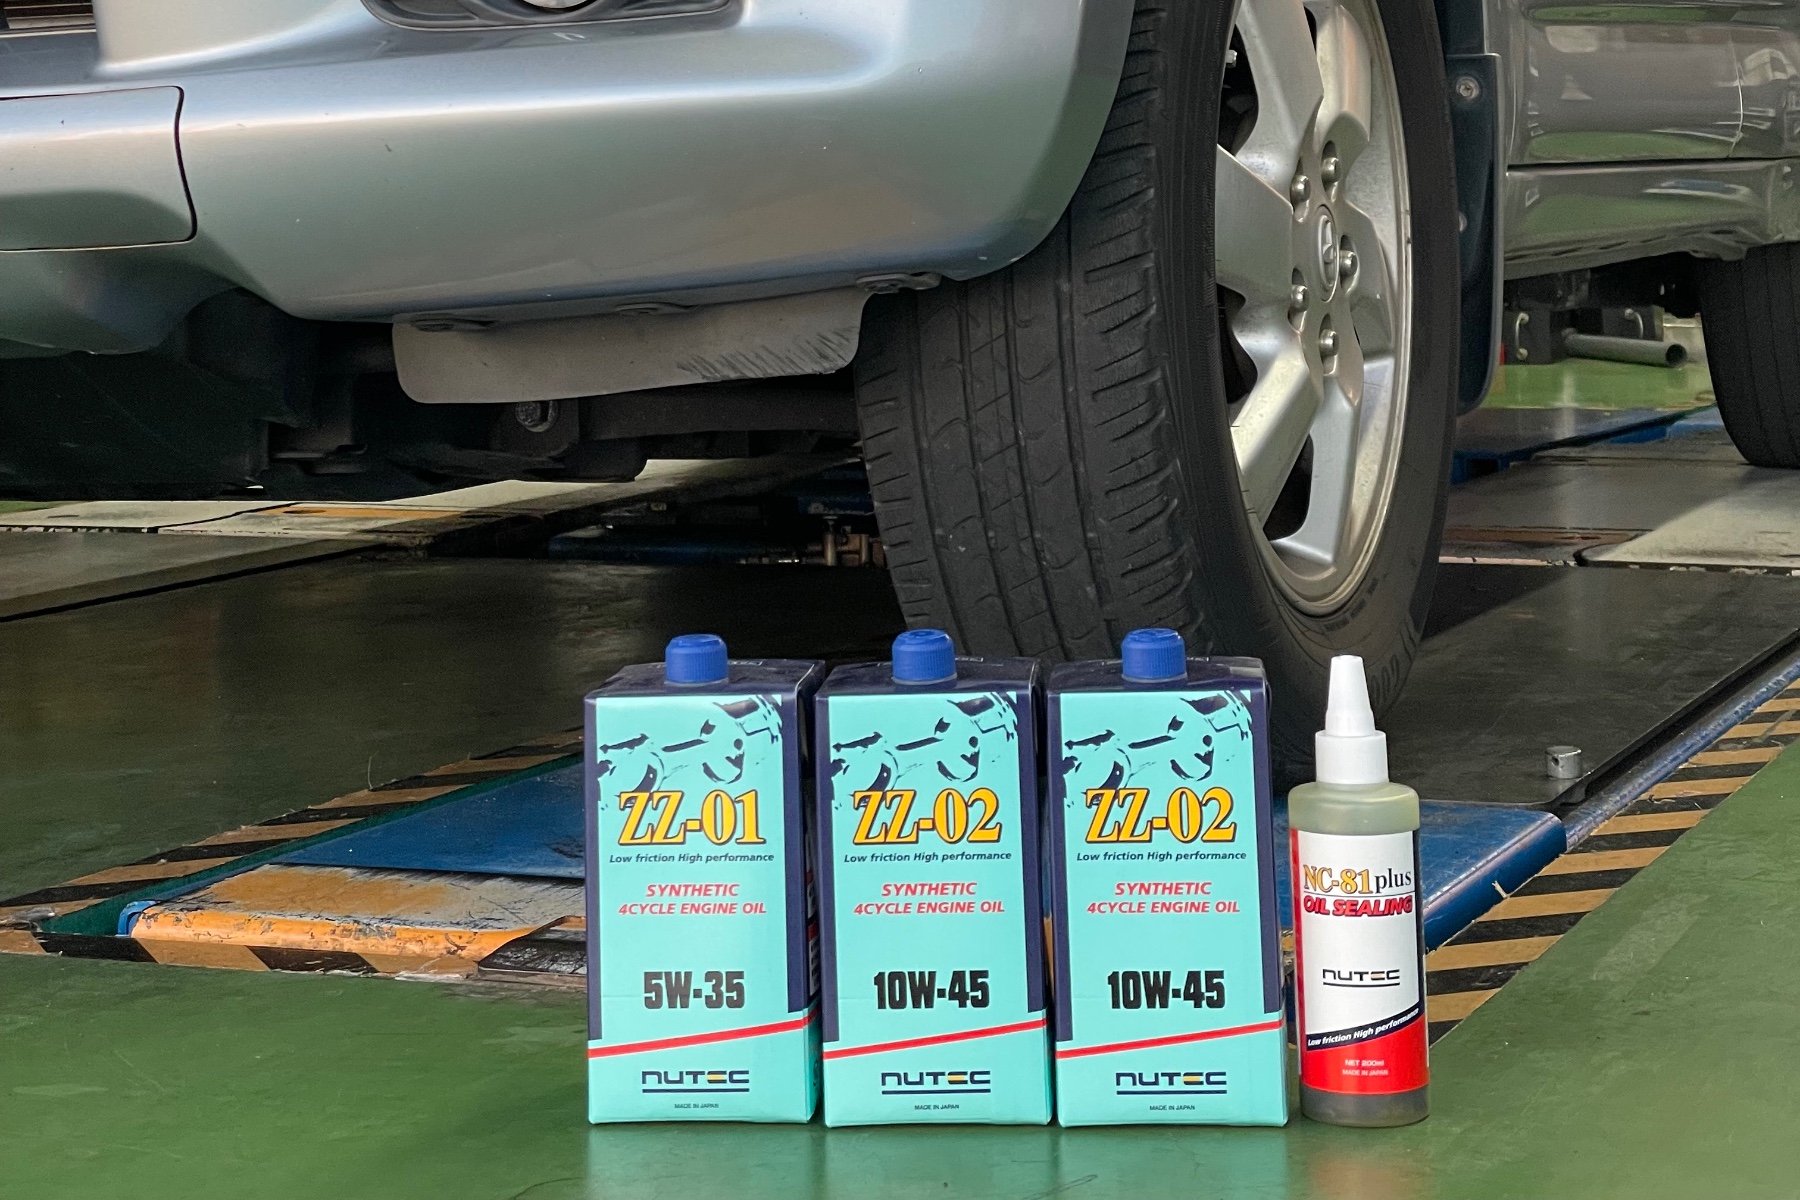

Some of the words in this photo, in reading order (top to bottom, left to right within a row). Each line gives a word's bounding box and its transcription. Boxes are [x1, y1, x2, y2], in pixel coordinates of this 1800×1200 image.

[617, 789, 767, 846] ZZ-01
[852, 787, 1003, 845] ZZ-02
[1085, 786, 1238, 844] ZZ-02
[609, 854, 632, 863] Low
[635, 853, 675, 863] friction
[678, 853, 703, 864] High
[705, 853, 775, 863] performance
[844, 854, 866, 863] Low
[870, 853, 910, 862] friction
[914, 852, 939, 863] High
[941, 852, 1012, 862] performance
[1077, 853, 1100, 861] Low
[1103, 852, 1144, 861] friction
[1147, 852, 1173, 862] High
[1175, 851, 1247, 862] performance
[1303, 864, 1373, 894] NC-81
[1375, 868, 1412, 893] plus
[646, 884, 740, 897] SYNTHETIC
[881, 882, 977, 896] SYNTHETIC
[1115, 882, 1212, 895] SYNTHETIC
[618, 903, 675, 915] 4CYCLE
[680, 903, 738, 915] ENGINE
[742, 903, 767, 914] OIL
[854, 902, 911, 915] 4CYCLE
[917, 902, 974, 914] ENGINE
[980, 901, 1005, 913] OIL
[1087, 902, 1146, 914] 4CYCLE
[1151, 902, 1210, 914] ENGINE
[1215, 901, 1240, 913] OIL
[1303, 895, 1330, 915] OIL
[1332, 895, 1413, 917] SEALING
[1322, 969, 1401, 982] NUTEC
[644, 971, 745, 1009] 5W-35
[874, 970, 990, 1010] 10W-45
[1108, 970, 1226, 1010] 10W-45
[1308, 1038, 1321, 1046] Low
[1322, 1033, 1352, 1045] friction
[1353, 1028, 1374, 1040] High
[1345, 1059, 1360, 1067] NET
[642, 1071, 750, 1084] NUTEC
[881, 1071, 991, 1086] NUTEC
[1116, 1071, 1227, 1086] NUTEC
[1369, 1069, 1388, 1077] JAPAN
